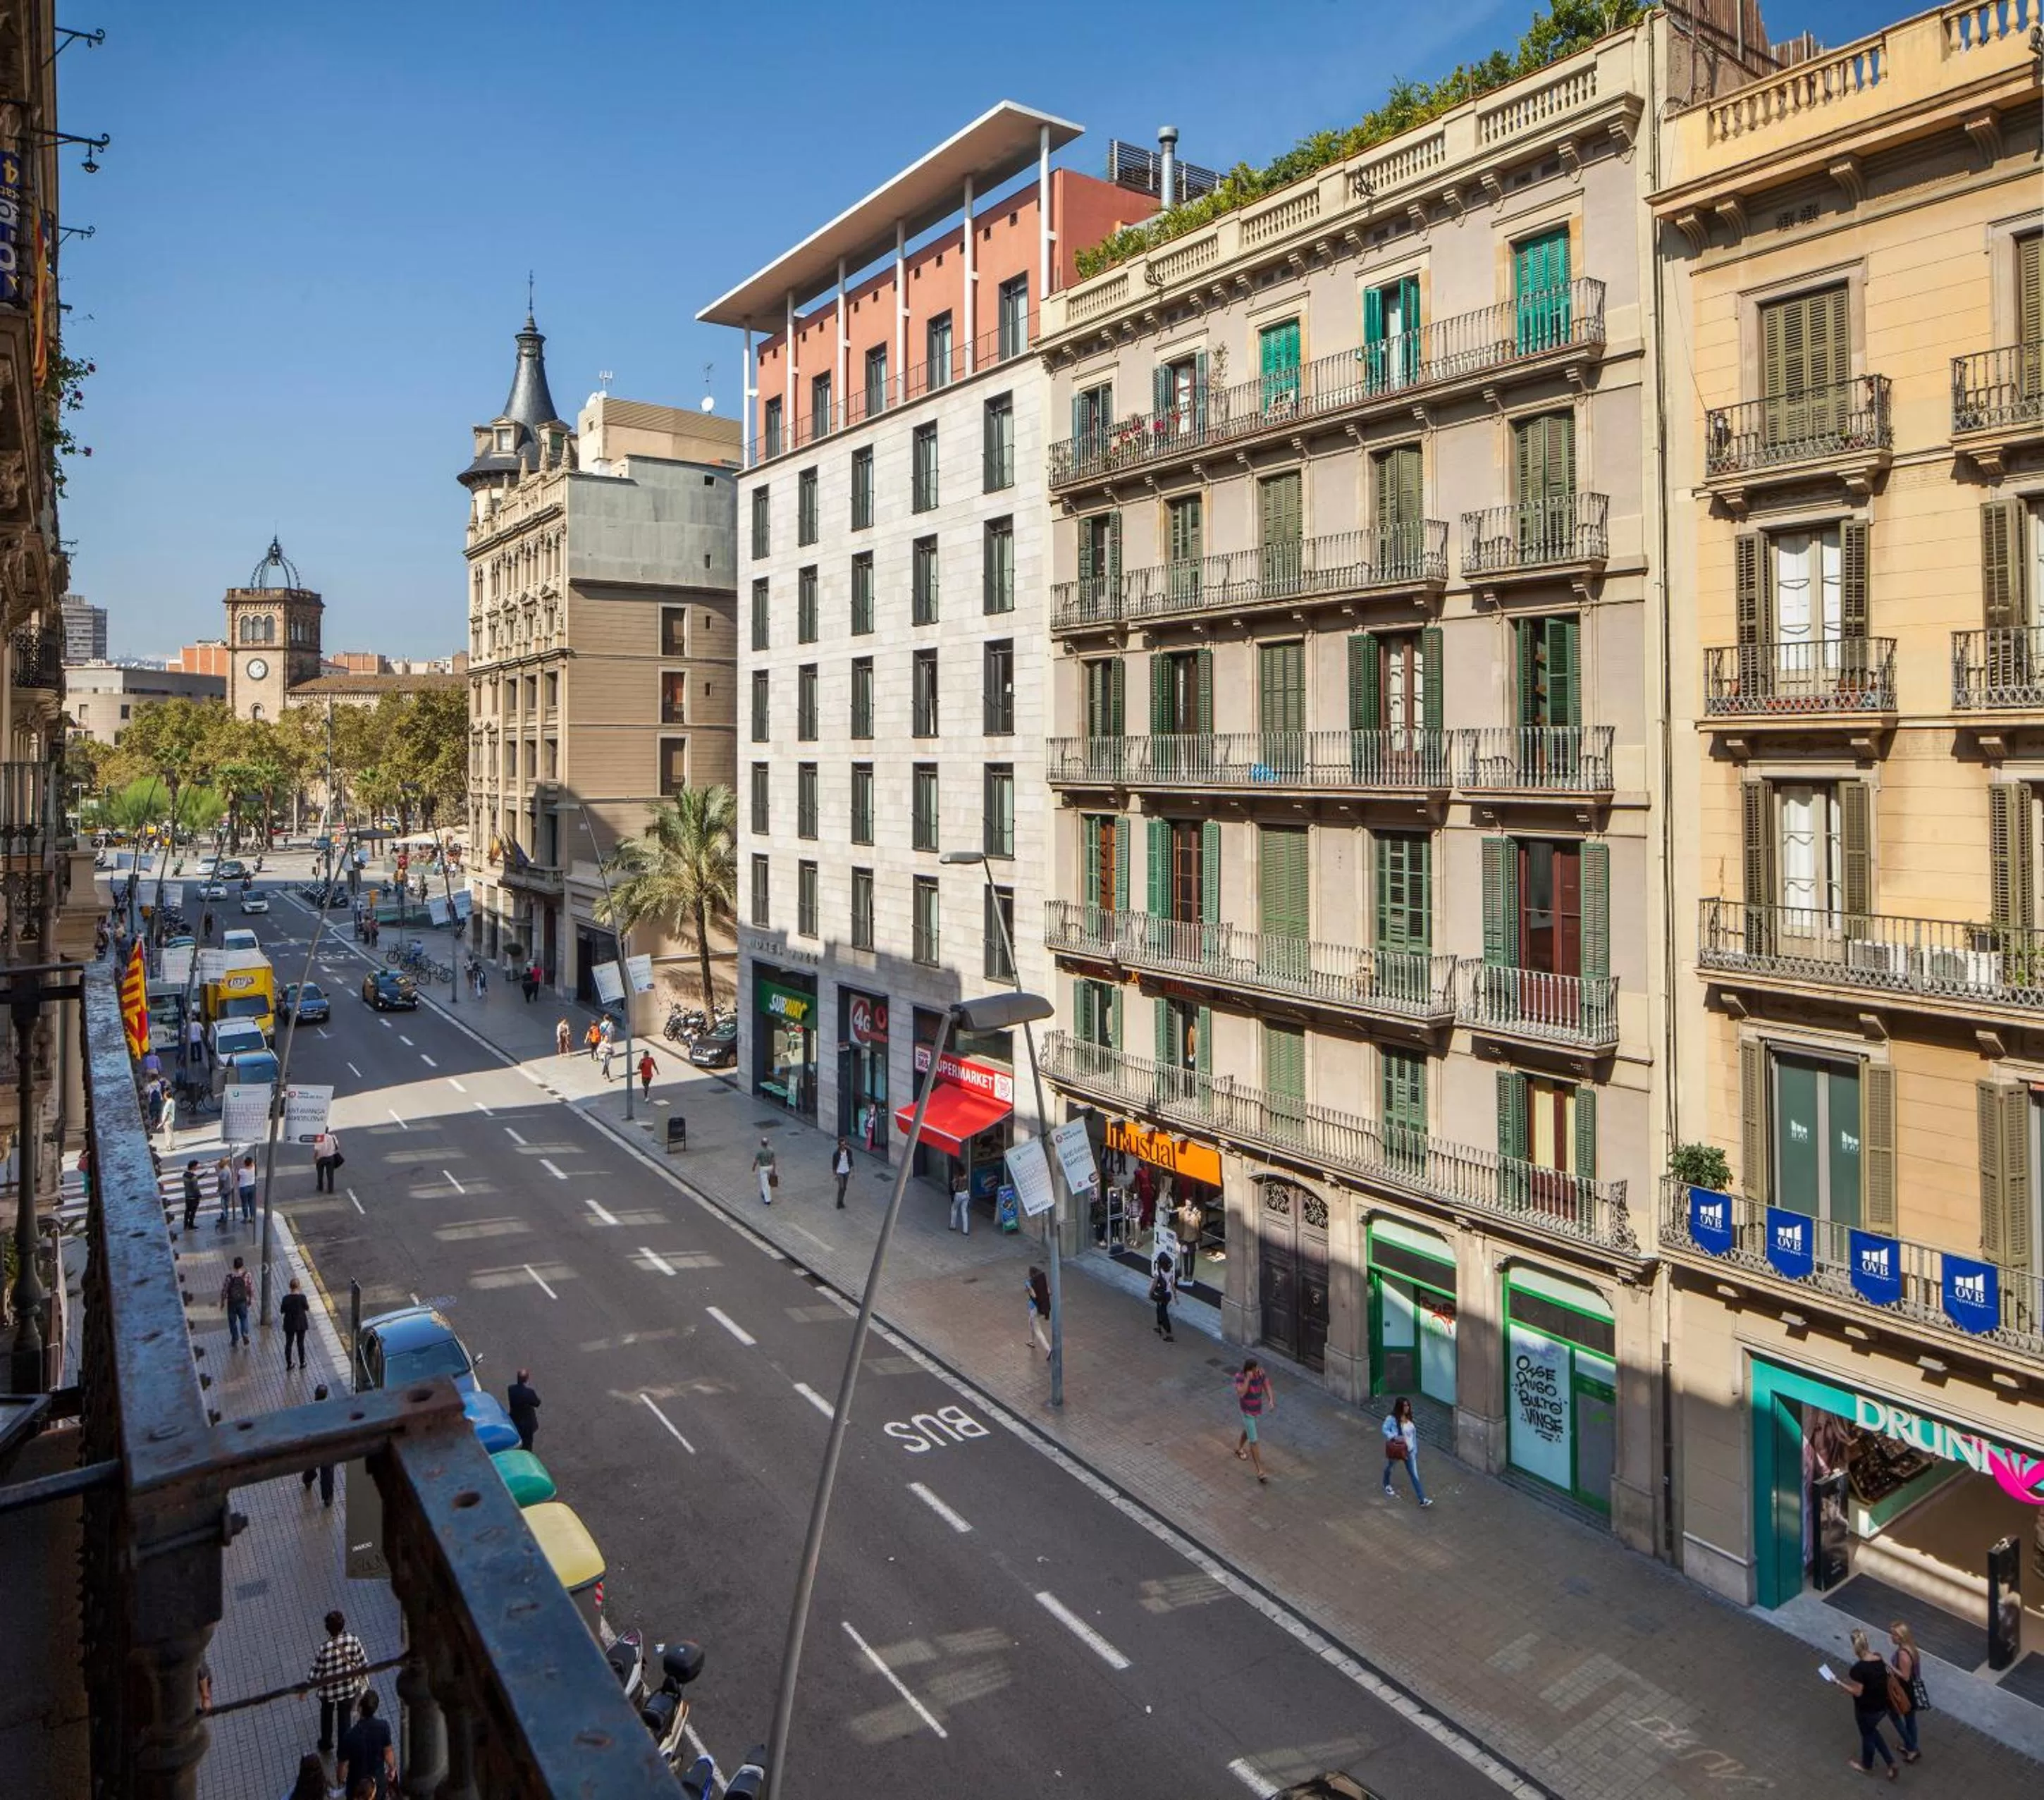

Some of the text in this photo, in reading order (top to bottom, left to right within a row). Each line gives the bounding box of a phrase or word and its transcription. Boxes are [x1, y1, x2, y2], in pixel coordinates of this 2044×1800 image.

[768, 993, 807, 1021] SUBWAY
[854, 1006, 871, 1033] 4G
[935, 1059, 994, 1091] UPERMARKET
[1700, 1214, 1722, 1228] OVB
[1778, 1235, 1802, 1252] OVB
[1861, 1260, 1889, 1276] OVB
[1955, 1286, 1985, 1303] OVB
[884, 1405, 991, 1453] BUS
